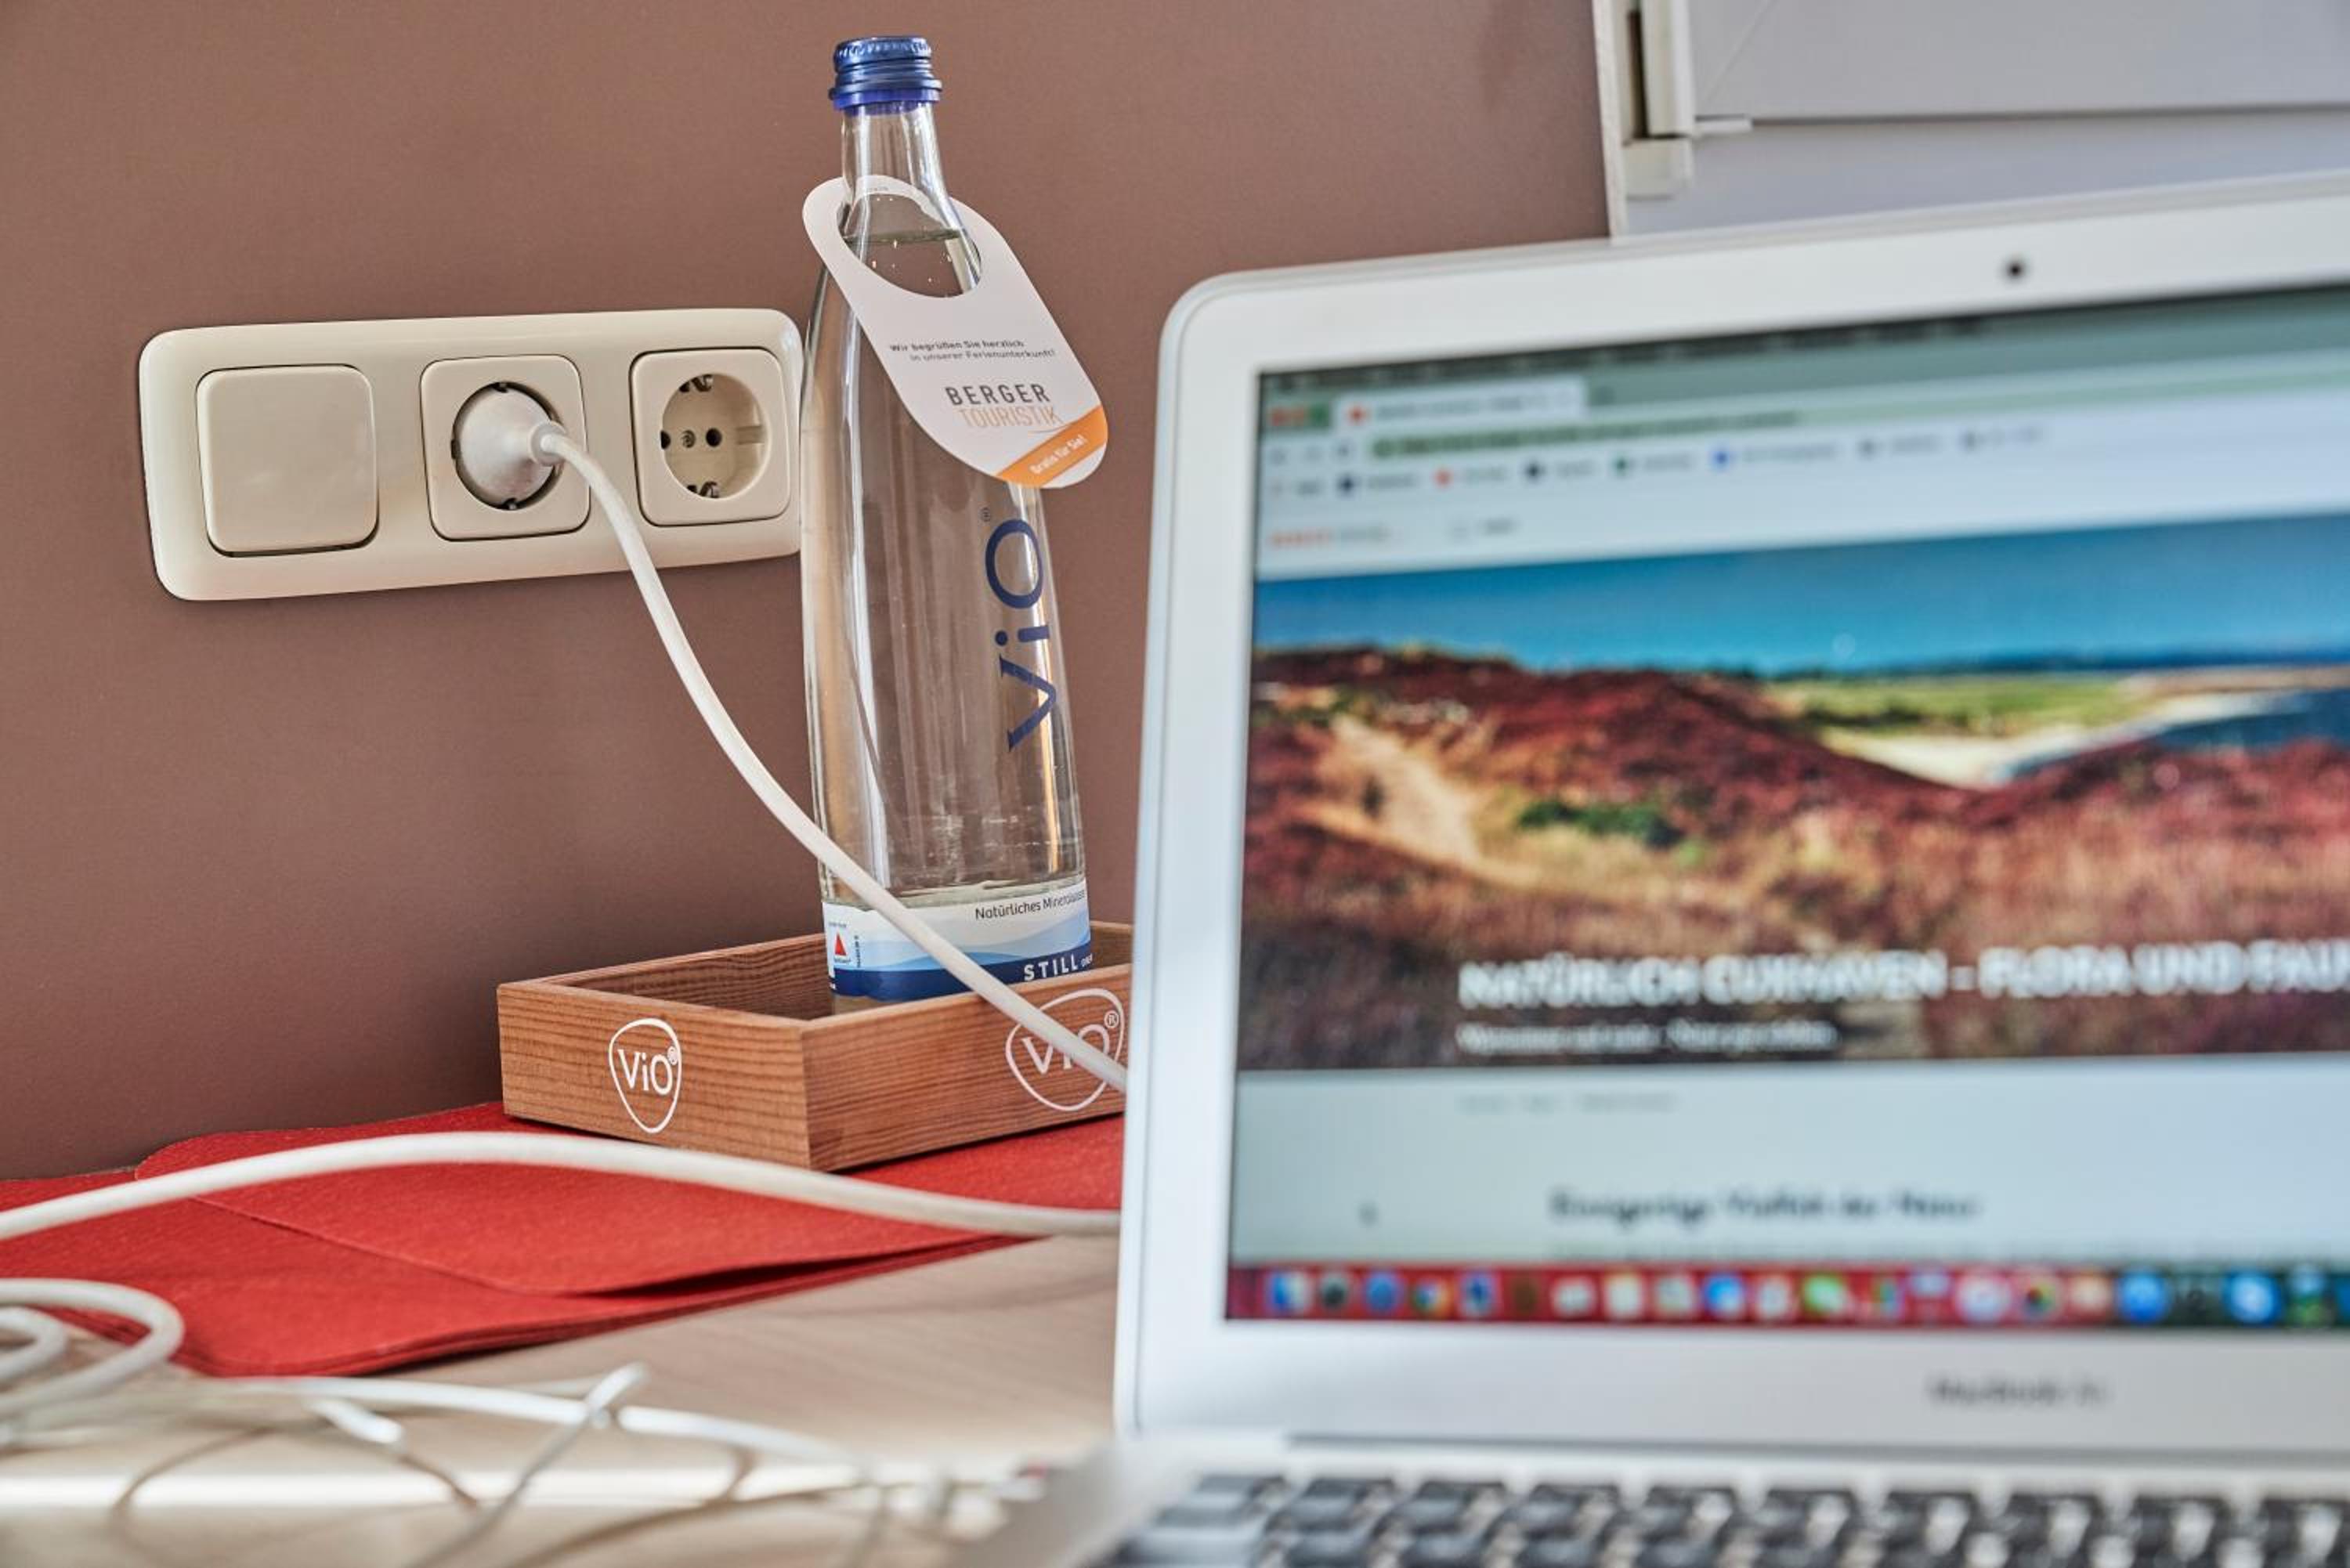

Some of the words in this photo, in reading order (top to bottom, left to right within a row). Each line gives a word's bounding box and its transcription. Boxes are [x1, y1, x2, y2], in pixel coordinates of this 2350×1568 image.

[911, 341, 962, 352] begrüßen
[964, 340, 981, 349] Sie
[982, 339, 1025, 349] herzlich
[924, 352, 964, 361] unserer
[945, 383, 1051, 406] BERGER
[959, 406, 1064, 427] TOURISTIK
[985, 518, 1057, 753] ViO
[974, 901, 1042, 920] Natürliches
[1023, 952, 1079, 981] STILL
[1978, 945, 2132, 999] FLORA
[2133, 941, 2247, 995] UND
[2247, 938, 2350, 992] FAU
[617, 1049, 673, 1096] ViO
